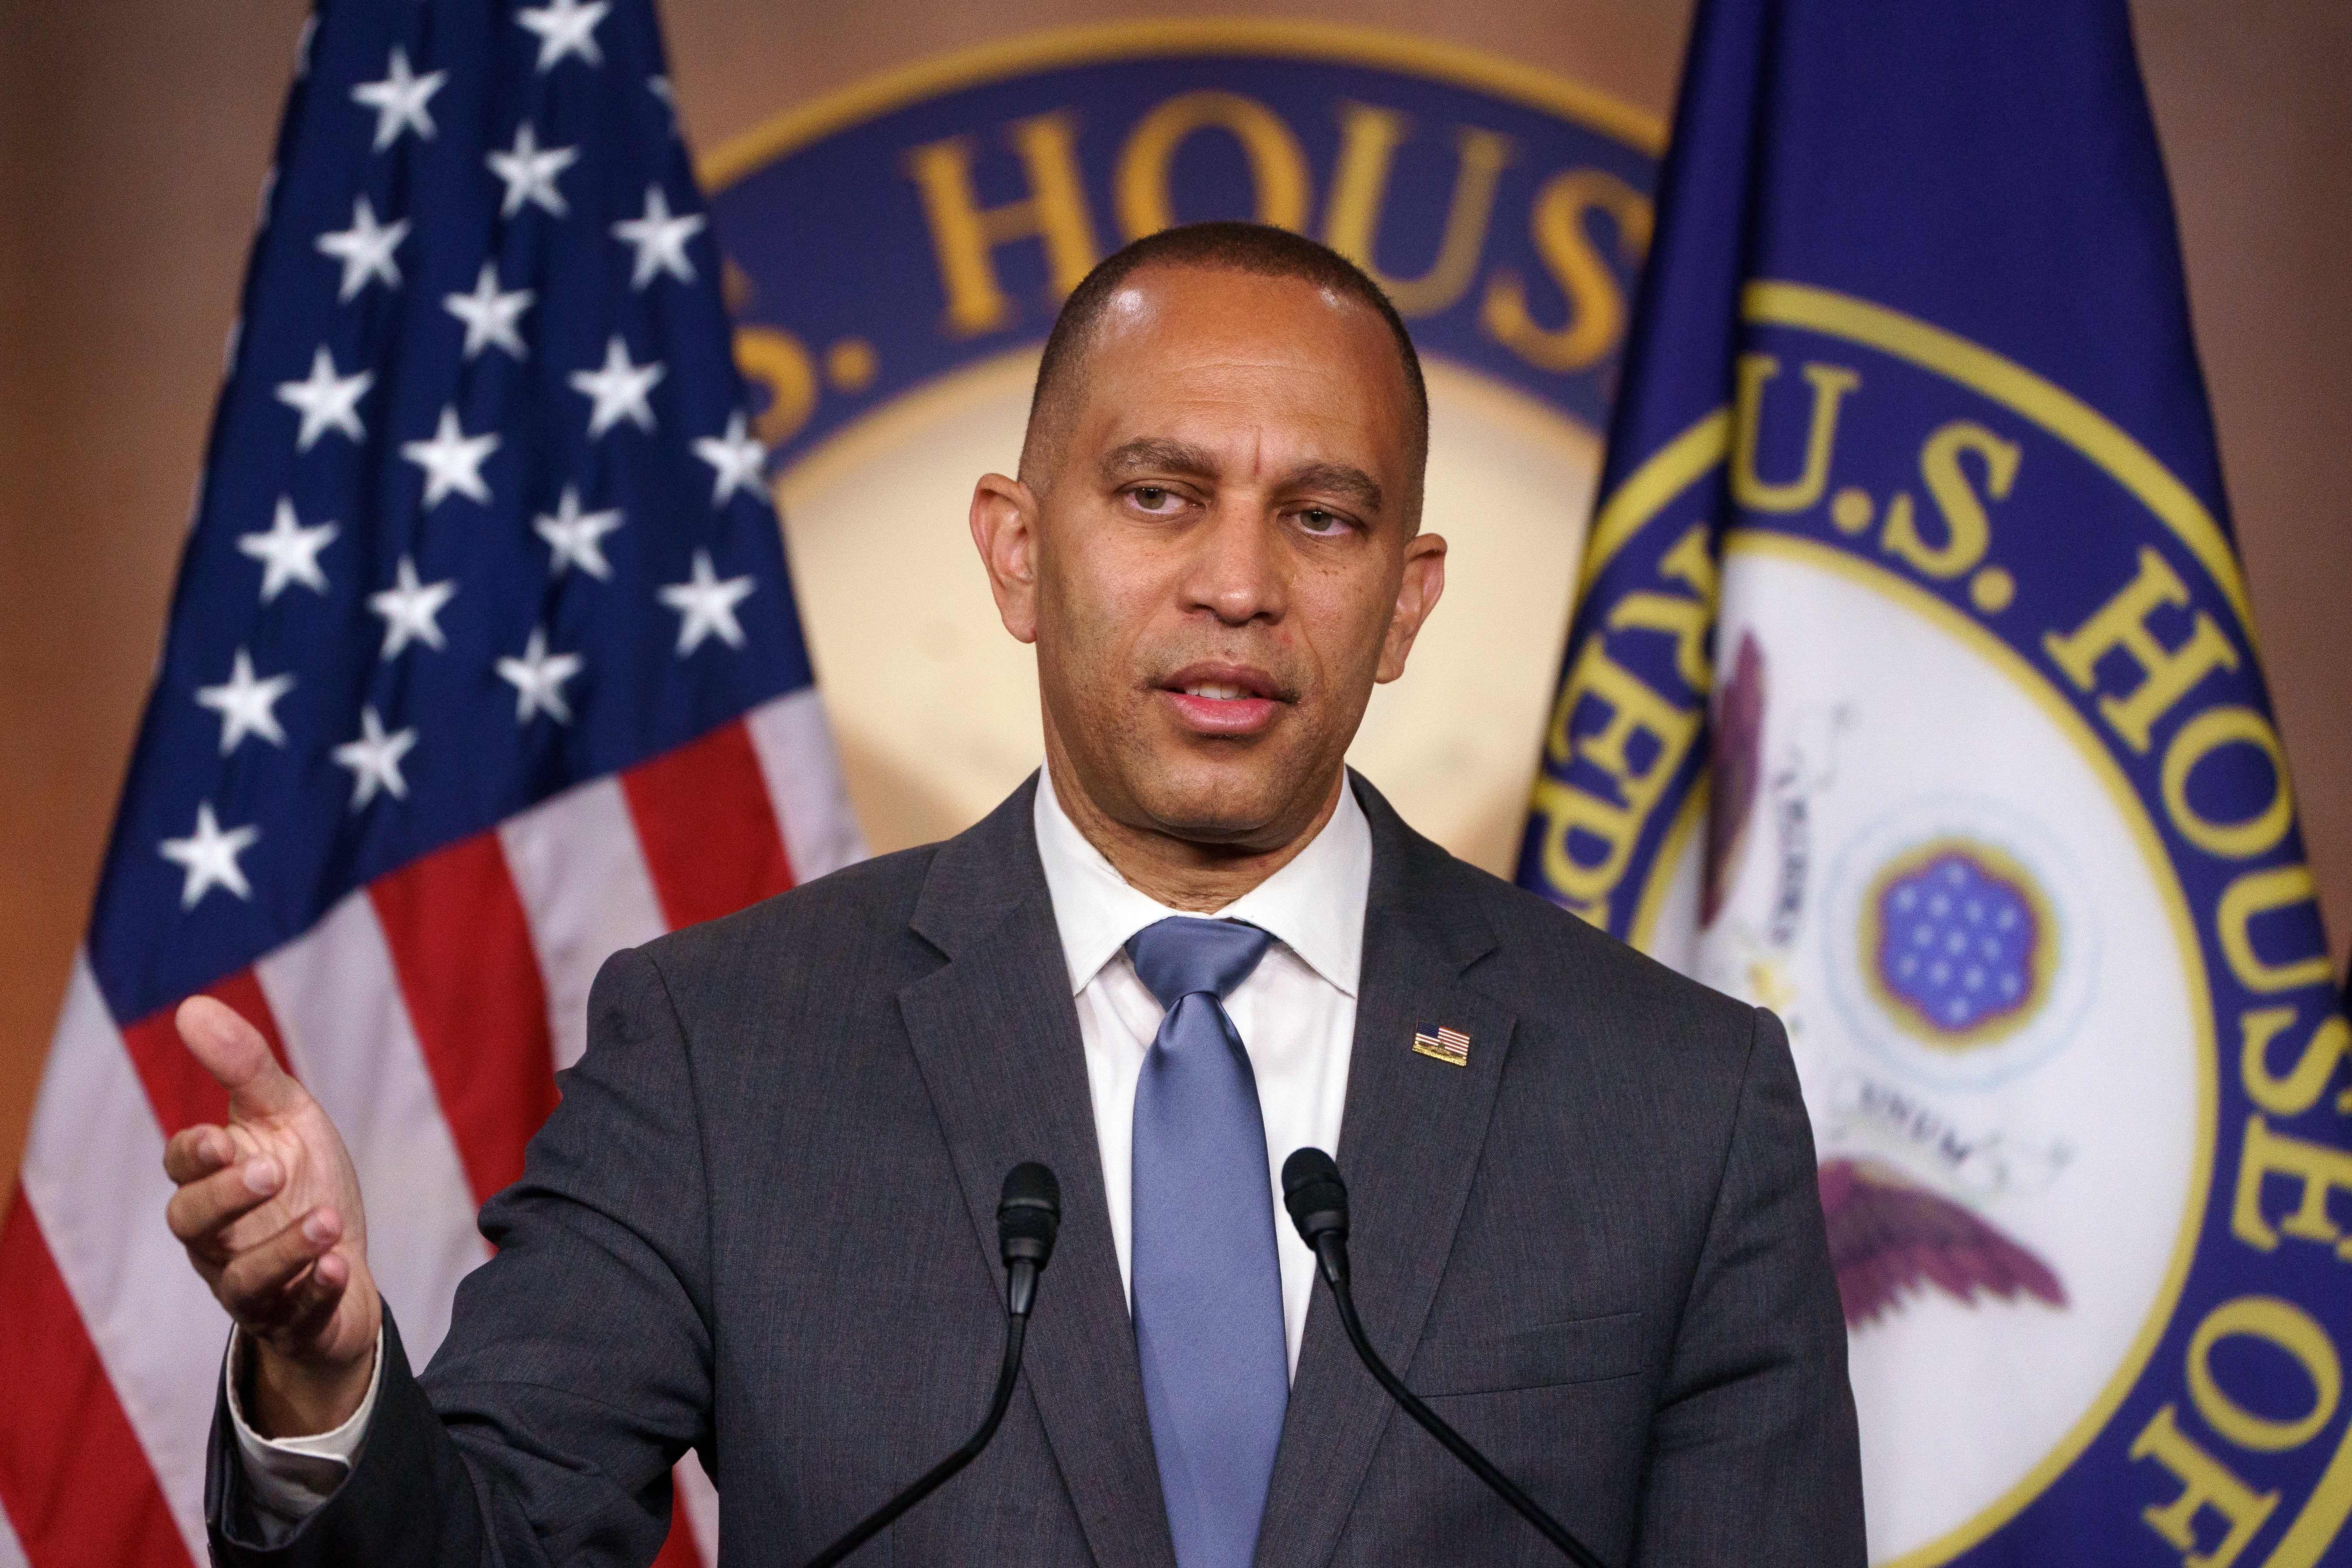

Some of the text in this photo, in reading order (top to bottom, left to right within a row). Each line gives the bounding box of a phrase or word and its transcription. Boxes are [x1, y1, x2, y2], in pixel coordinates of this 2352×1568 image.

[1729, 352, 2352, 1568] U.S. HOUSE OF
